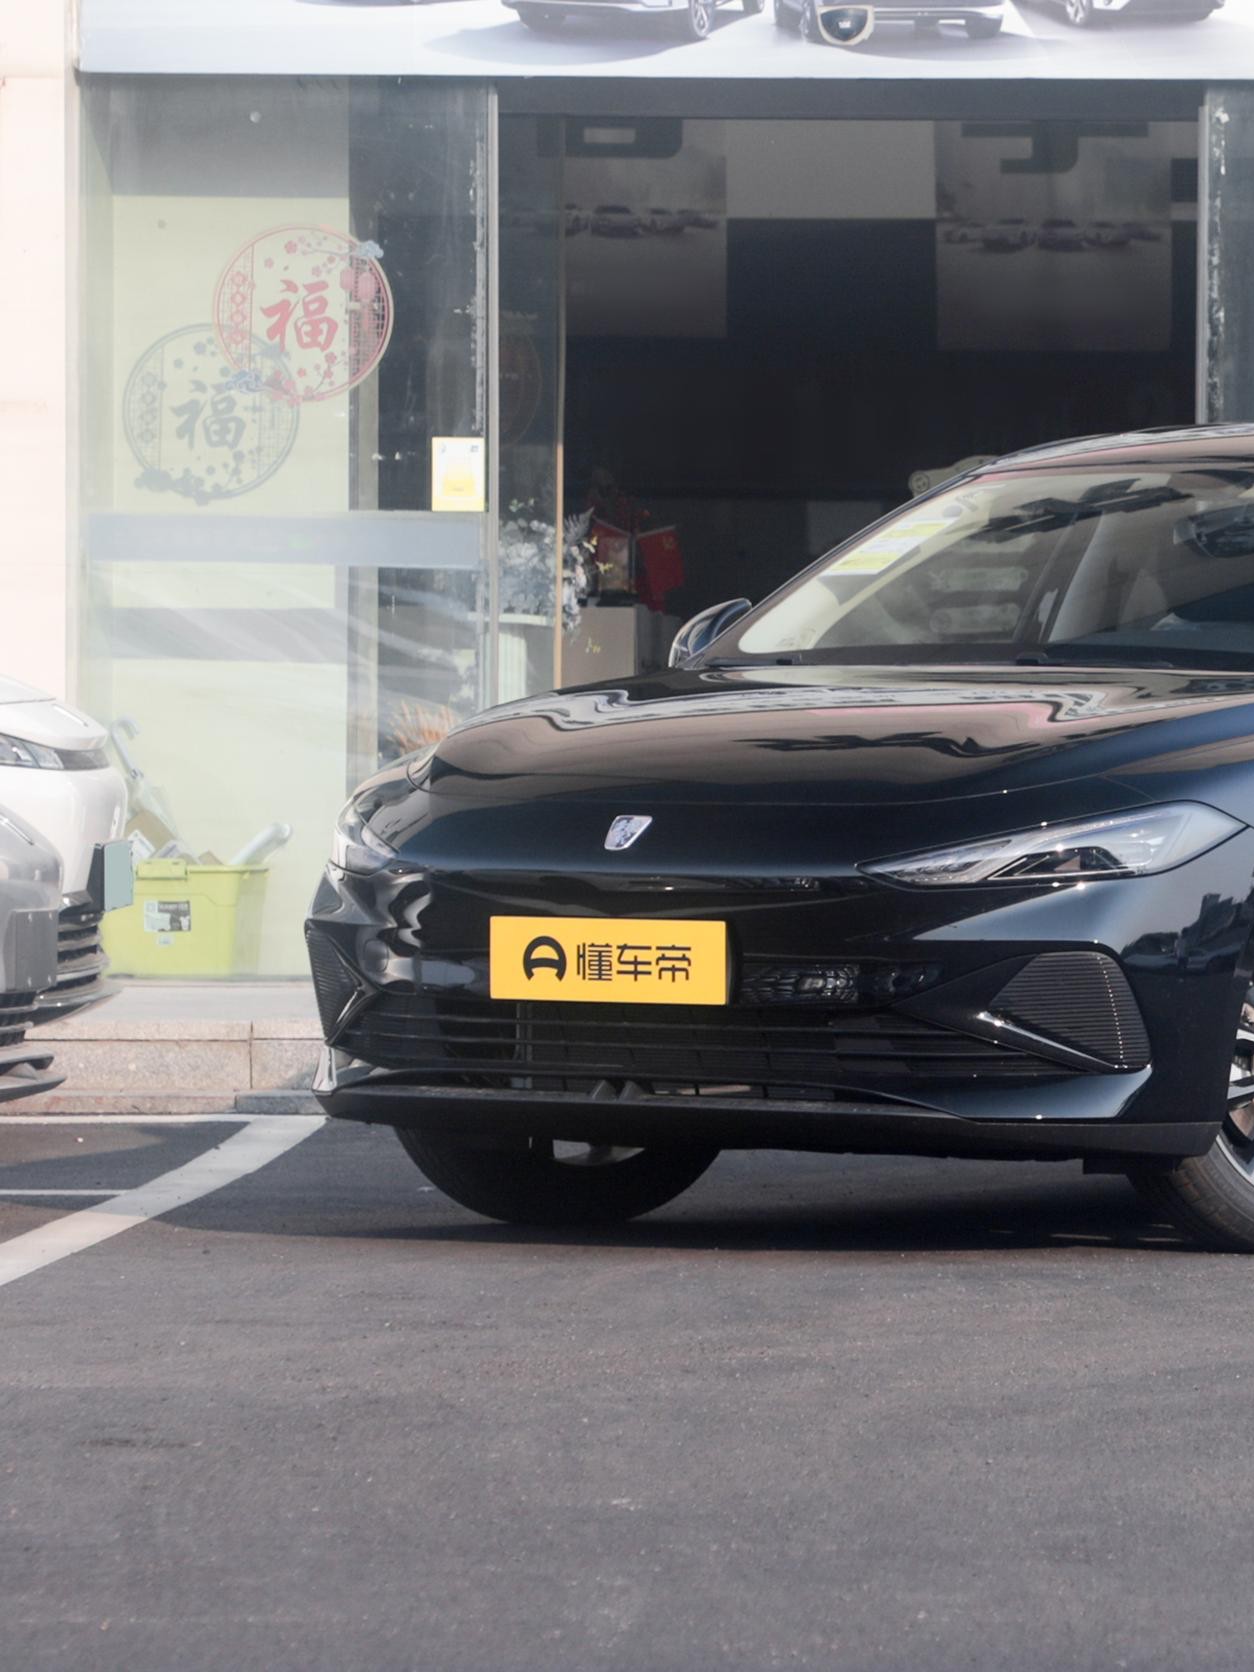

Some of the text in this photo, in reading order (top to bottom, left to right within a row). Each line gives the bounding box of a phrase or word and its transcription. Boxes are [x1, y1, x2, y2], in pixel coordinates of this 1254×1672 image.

[260, 279, 339, 352] 福
[576, 942, 692, 983] 懂车帝
